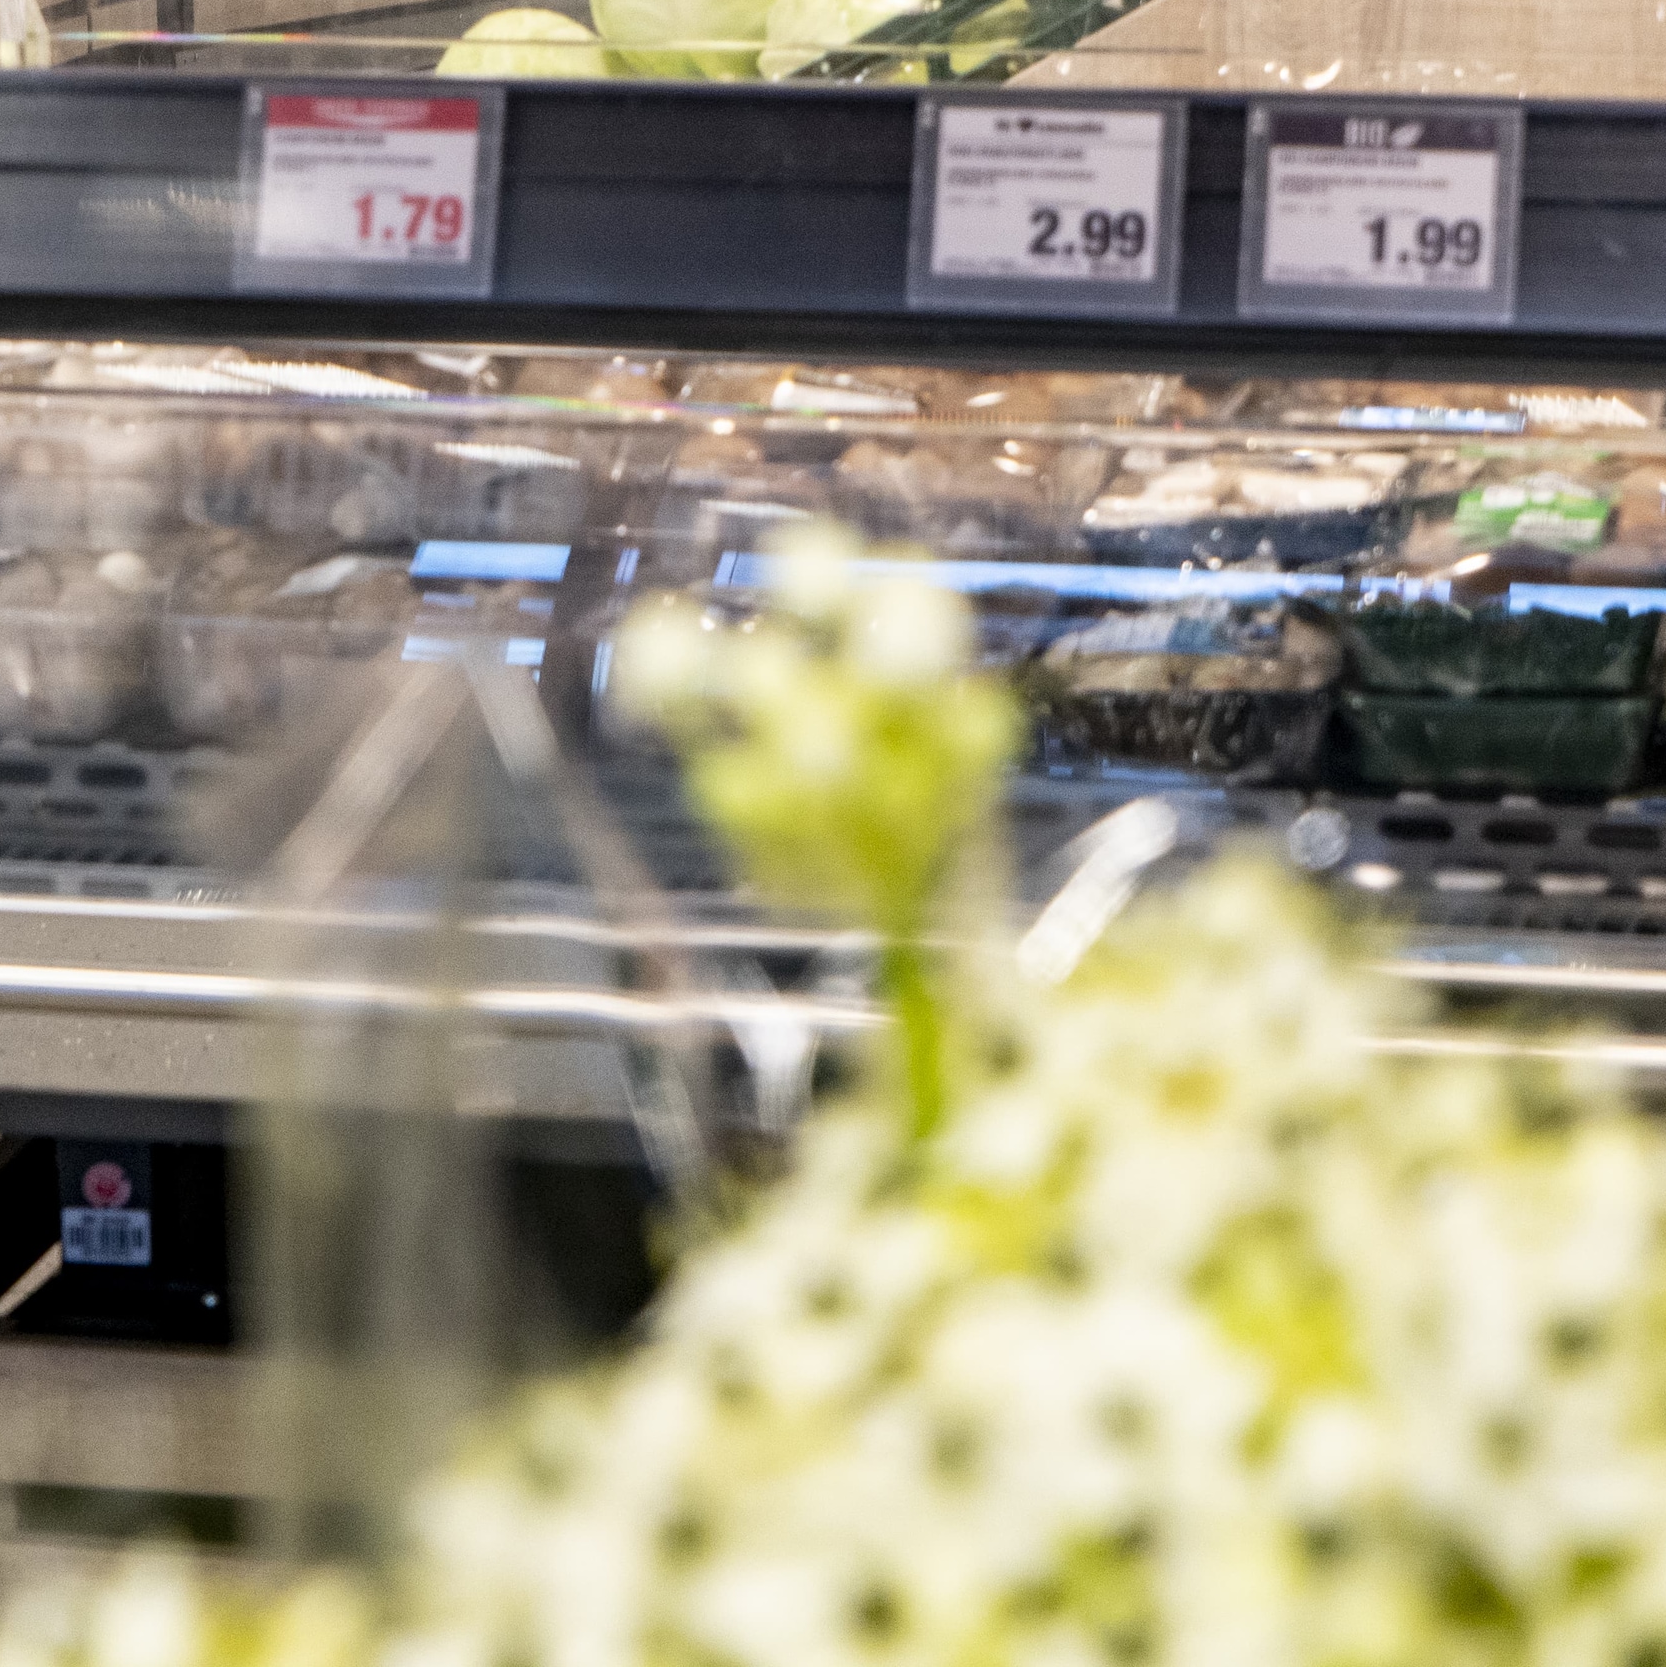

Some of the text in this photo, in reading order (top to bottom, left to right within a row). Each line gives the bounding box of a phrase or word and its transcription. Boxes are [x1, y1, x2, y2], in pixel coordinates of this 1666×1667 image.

[351, 191, 467, 244] 1.79
[1027, 207, 1147, 260] 2.99
[1363, 215, 1483, 268] 1.99
